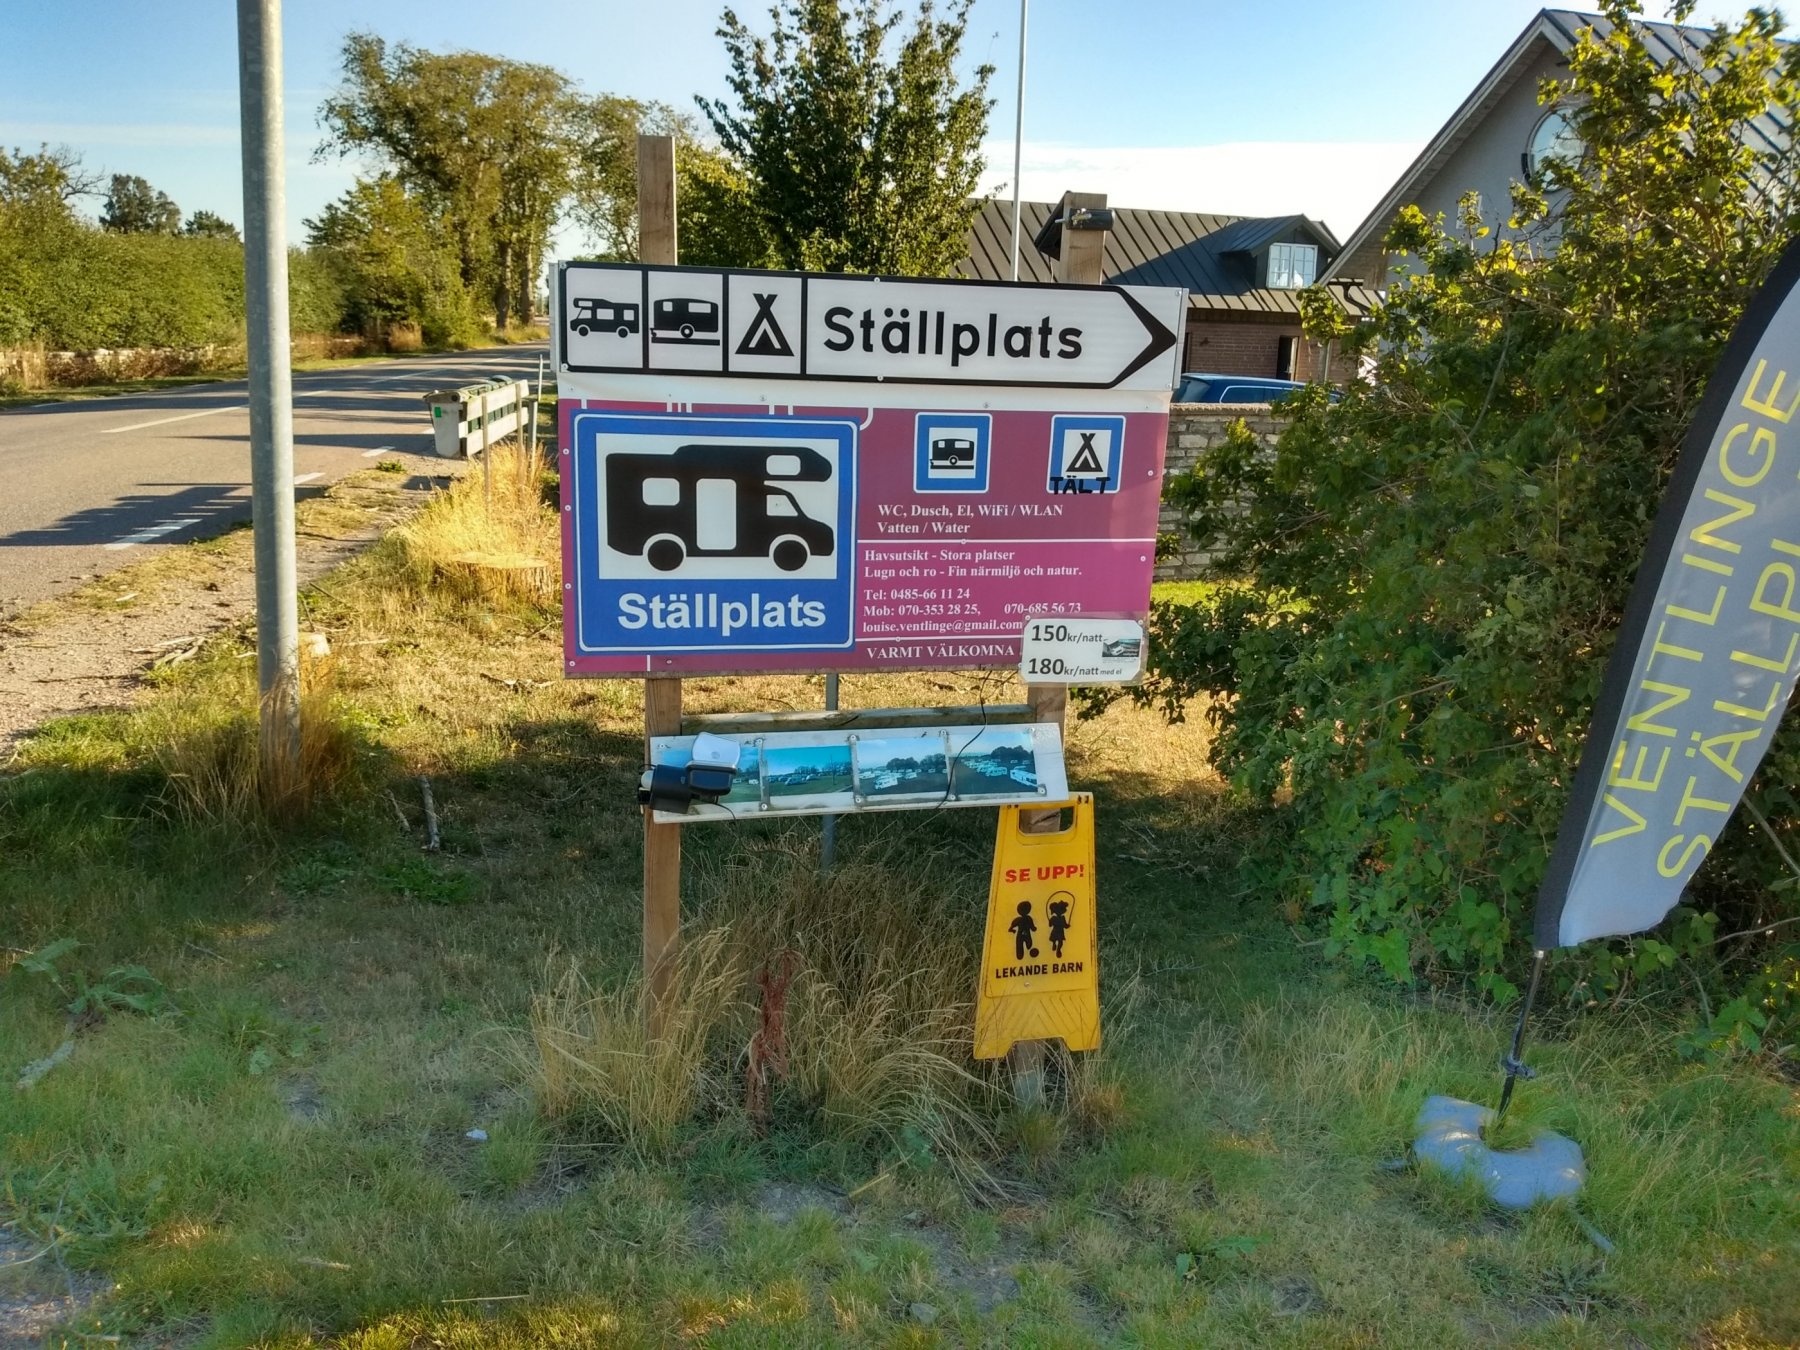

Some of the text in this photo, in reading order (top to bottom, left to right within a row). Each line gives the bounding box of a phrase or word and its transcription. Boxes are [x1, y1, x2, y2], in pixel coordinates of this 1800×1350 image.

[823, 306, 1083, 367] Ställplats
[1050, 475, 1111, 494] TÄLT
[878, 504, 1063, 518] WC, Dusch, El, WiFi / WLAN
[877, 522, 970, 534] Vatten / Water
[864, 550, 928, 561] Havsutsikt
[940, 550, 972, 561] Stora
[975, 550, 1015, 563] platser
[864, 566, 896, 579] Lugn
[899, 566, 920, 577] och
[922, 568, 937, 577] ro
[948, 565, 967, 577] Fin
[970, 565, 1021, 579] närmiljö
[1023, 565, 1044, 577] och
[1047, 566, 1082, 576] natur.
[864, 588, 970, 600] Tel: 0485-66 11 24
[863, 602, 1081, 617] Mob: 070-353 28 25, 070-685 56 73
[1591, 358, 1800, 848] VENTLINGE
[618, 593, 826, 637] Ställplats
[863, 620, 1023, 633] louise.ventlinge@gmail.com
[867, 642, 1015, 659] VARMT VÄLKOMNA
[1005, 864, 1084, 884] SE UPP!
[995, 961, 1083, 979] LEKANDE BARN
